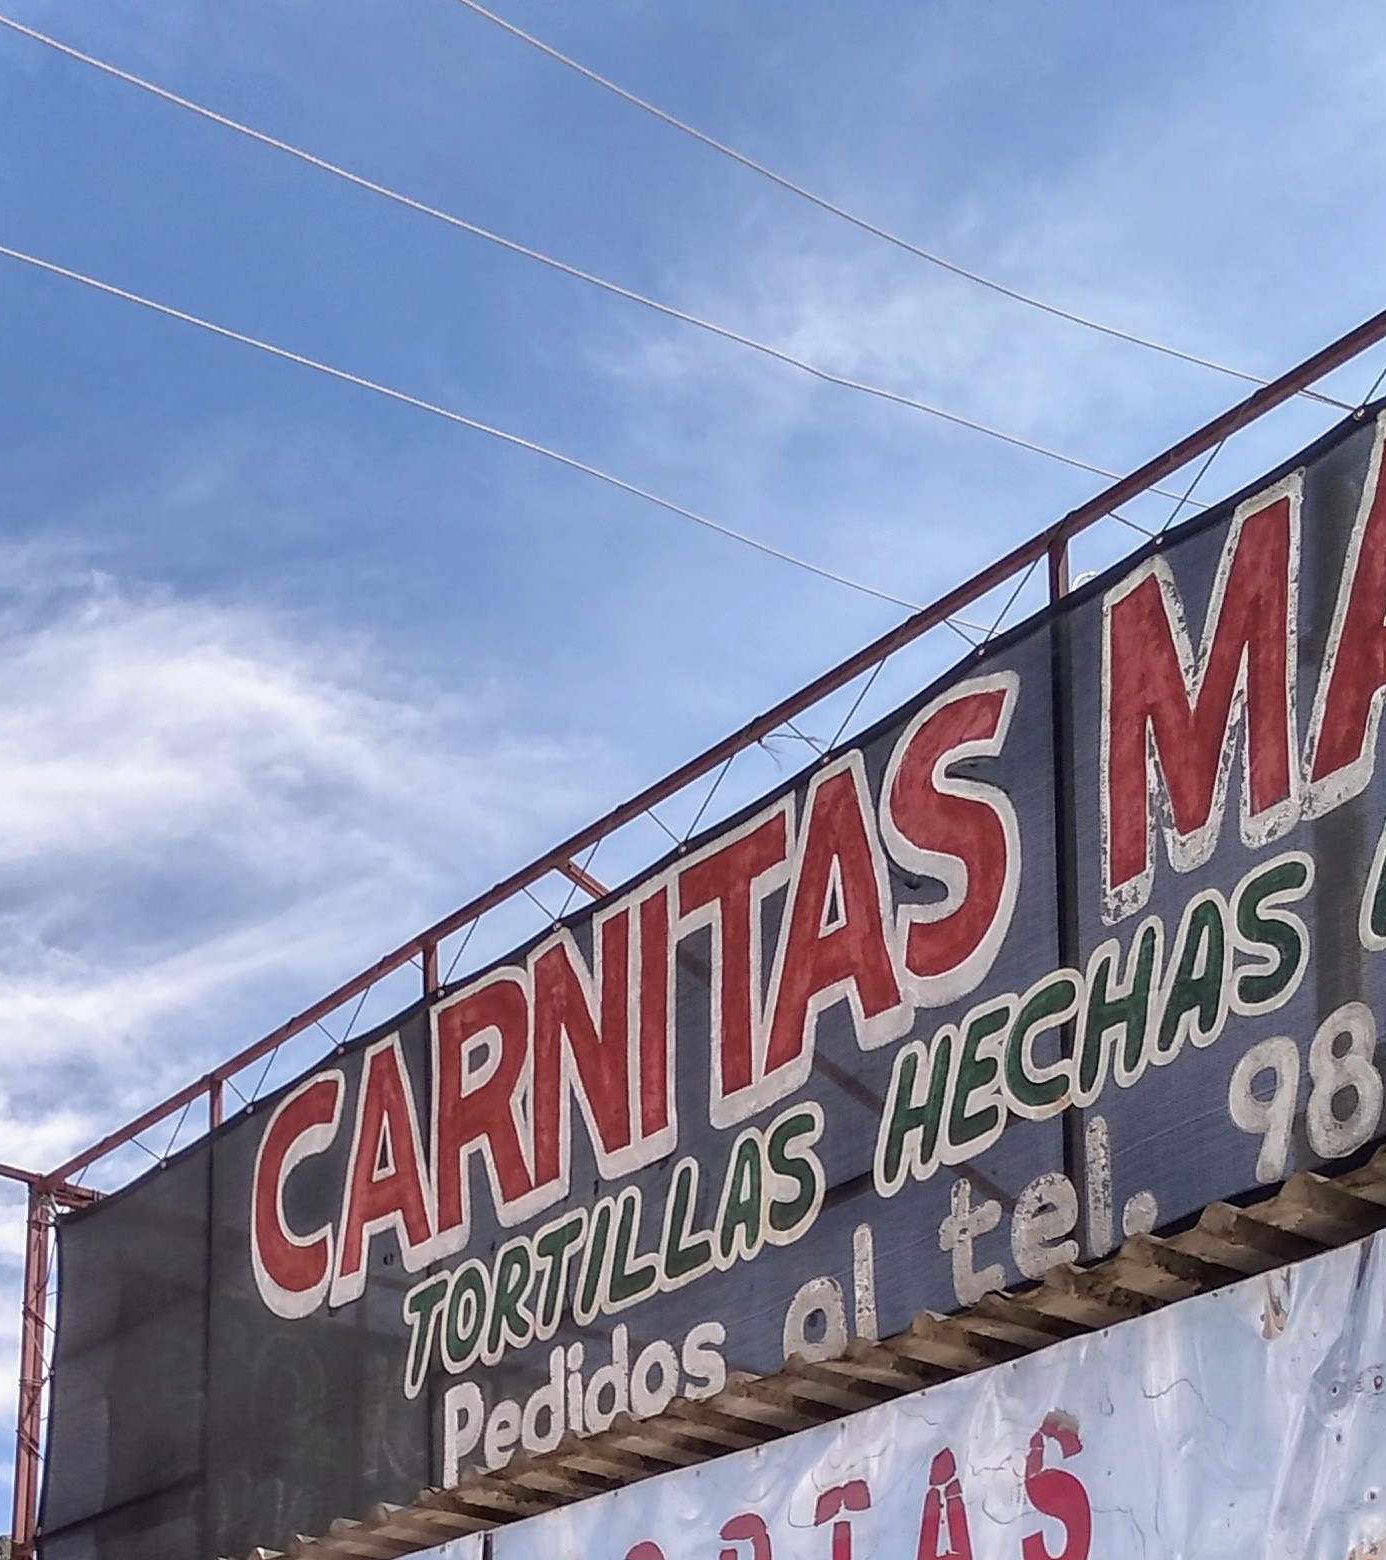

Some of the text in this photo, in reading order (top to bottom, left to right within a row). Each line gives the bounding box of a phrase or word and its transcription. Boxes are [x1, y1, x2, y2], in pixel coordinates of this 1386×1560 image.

[250, 664, 1023, 1319] CARNITAS
[402, 1100, 826, 1400] TORTILLAS
[872, 850, 1311, 1199] HECHAS
[442, 1320, 727, 1491] Pedidos
[938, 1116, 1159, 1307] tel.
